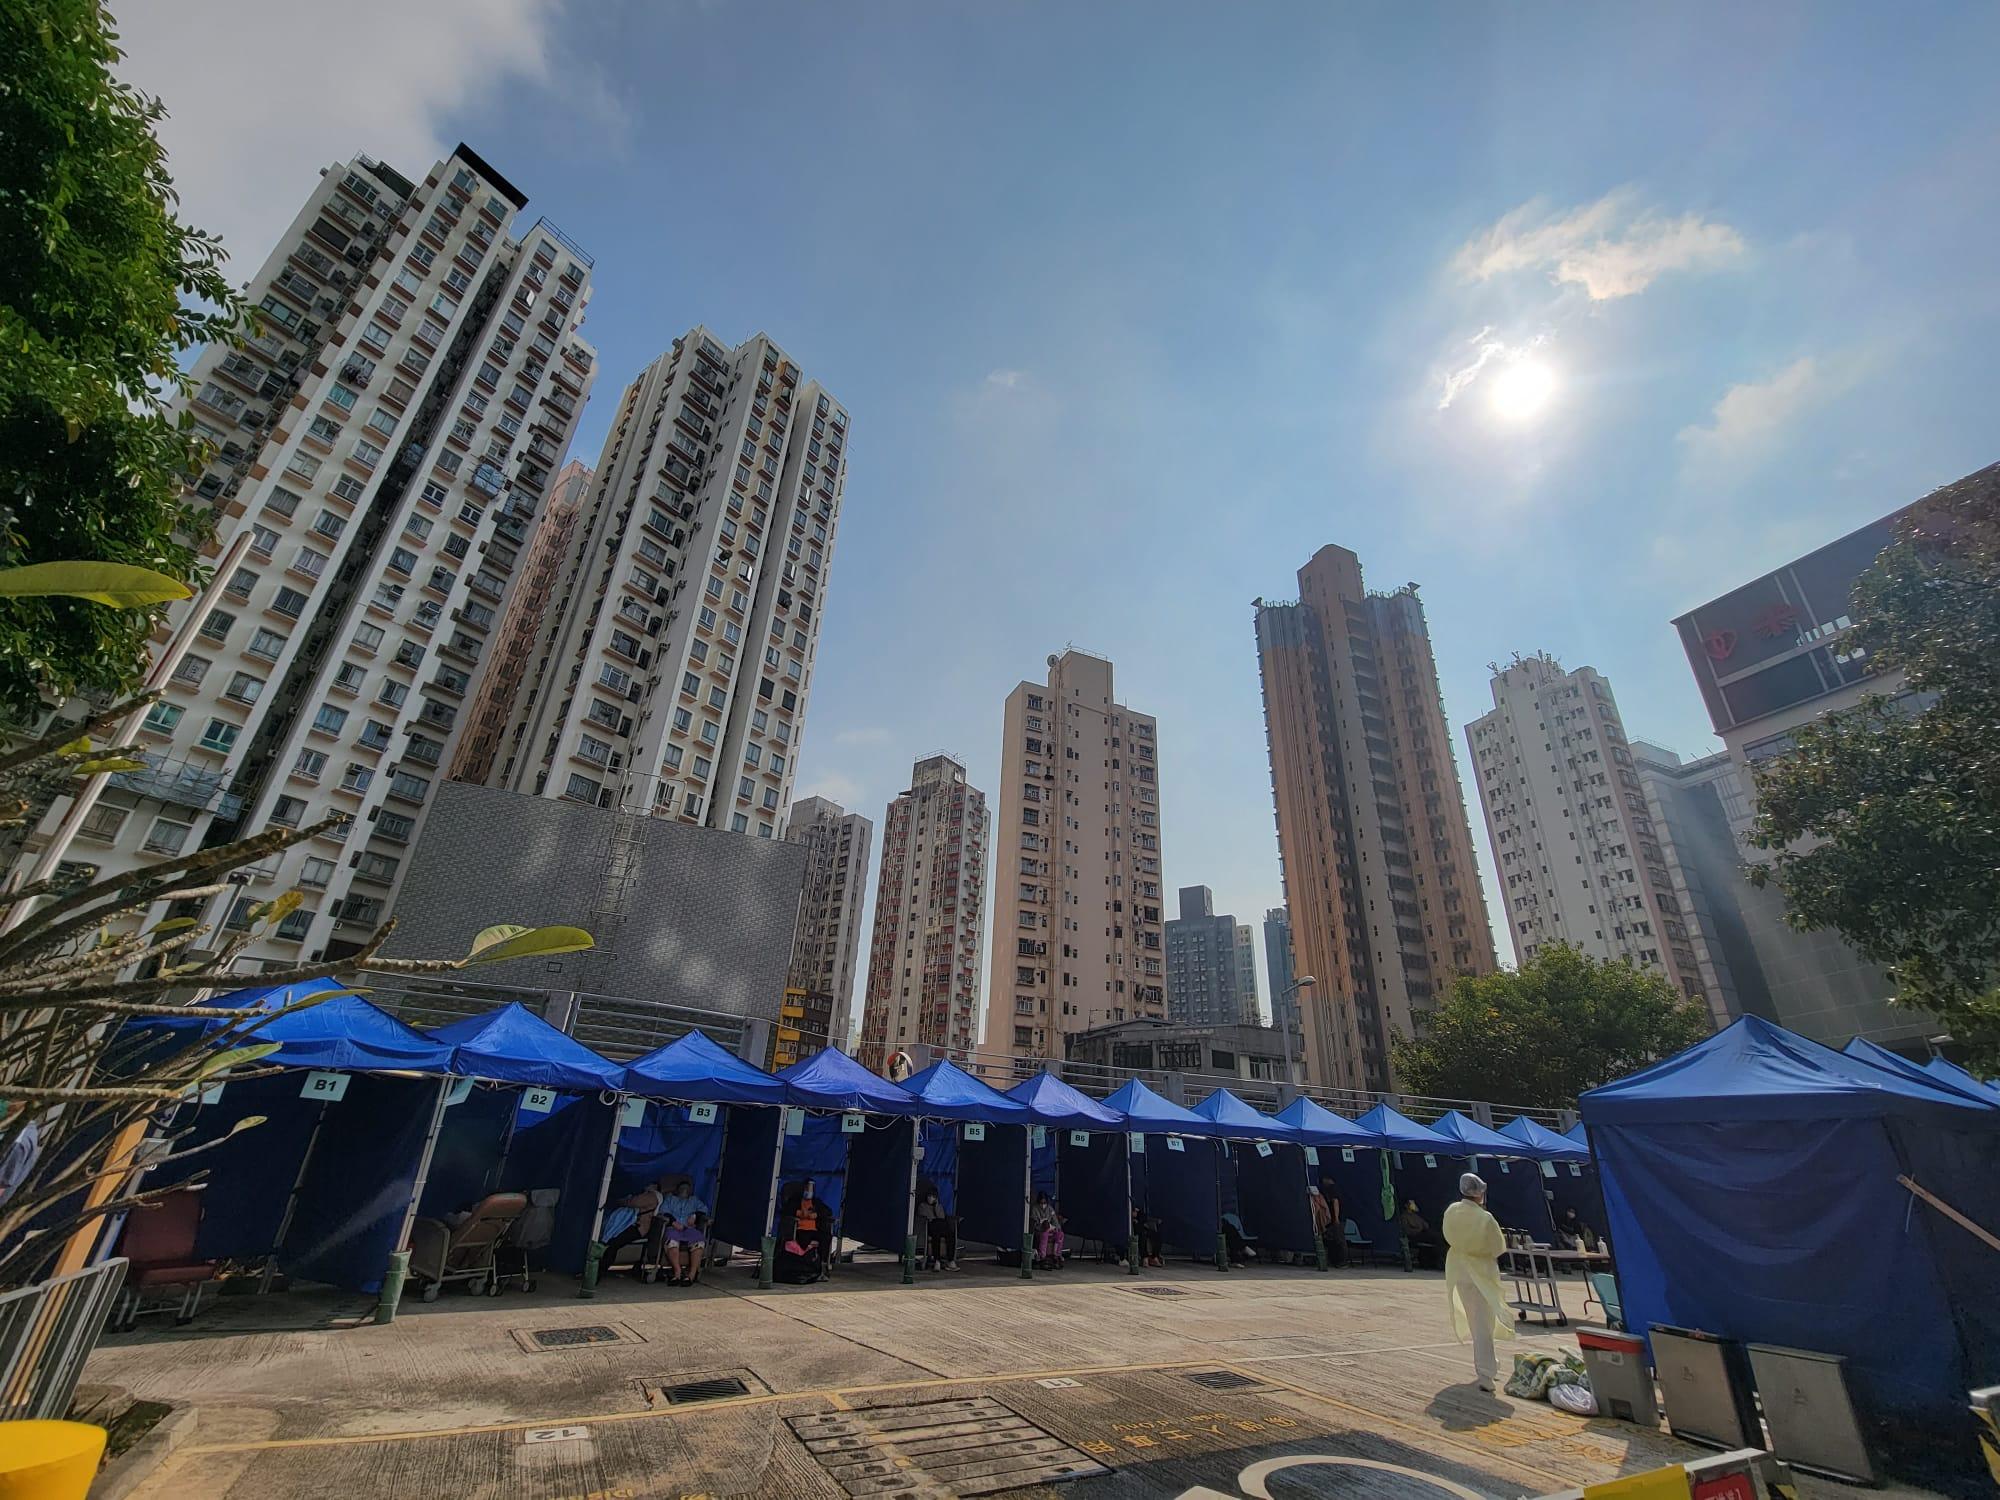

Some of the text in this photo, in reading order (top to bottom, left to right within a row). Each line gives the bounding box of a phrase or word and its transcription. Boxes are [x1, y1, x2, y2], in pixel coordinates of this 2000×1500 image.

[313, 1078, 337, 1093] B1
[530, 1093, 549, 1106] B2
[696, 1107, 711, 1118] B3
[847, 1118, 860, 1129] B4
[969, 1127, 981, 1137] B5
[535, 1430, 577, 1440] 12
